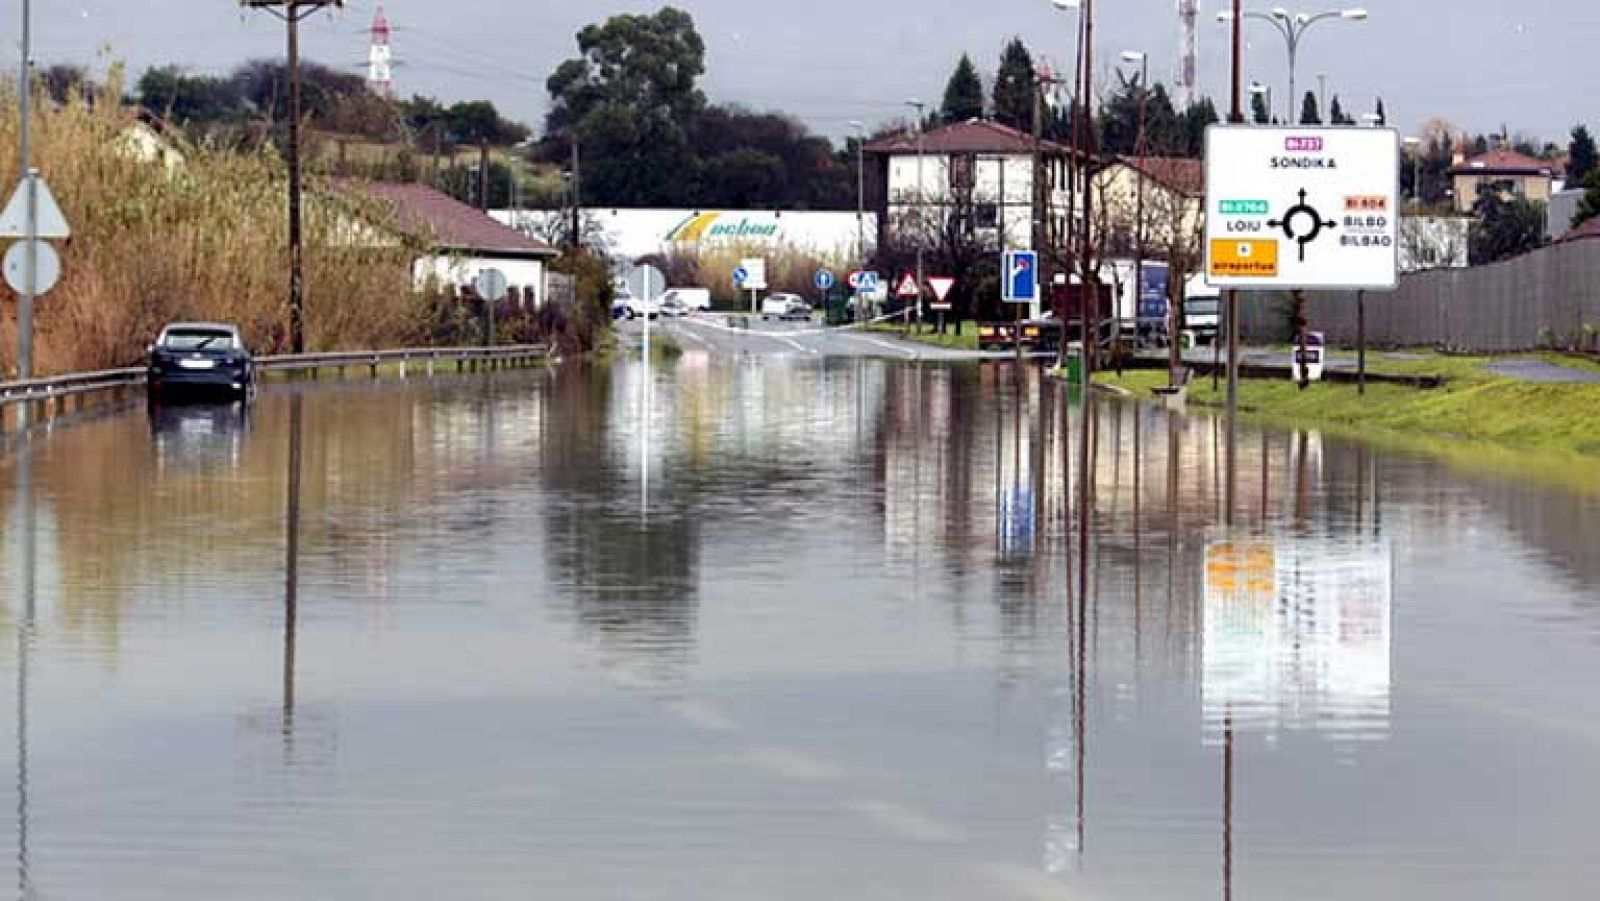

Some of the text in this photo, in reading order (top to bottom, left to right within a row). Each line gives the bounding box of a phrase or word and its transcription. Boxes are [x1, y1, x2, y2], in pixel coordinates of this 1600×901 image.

[1270, 157, 1336, 168] SONDIKA
[1227, 221, 1261, 232] LOIU
[1343, 216, 1387, 228] BILBO
[1340, 236, 1391, 247] BILBAO
